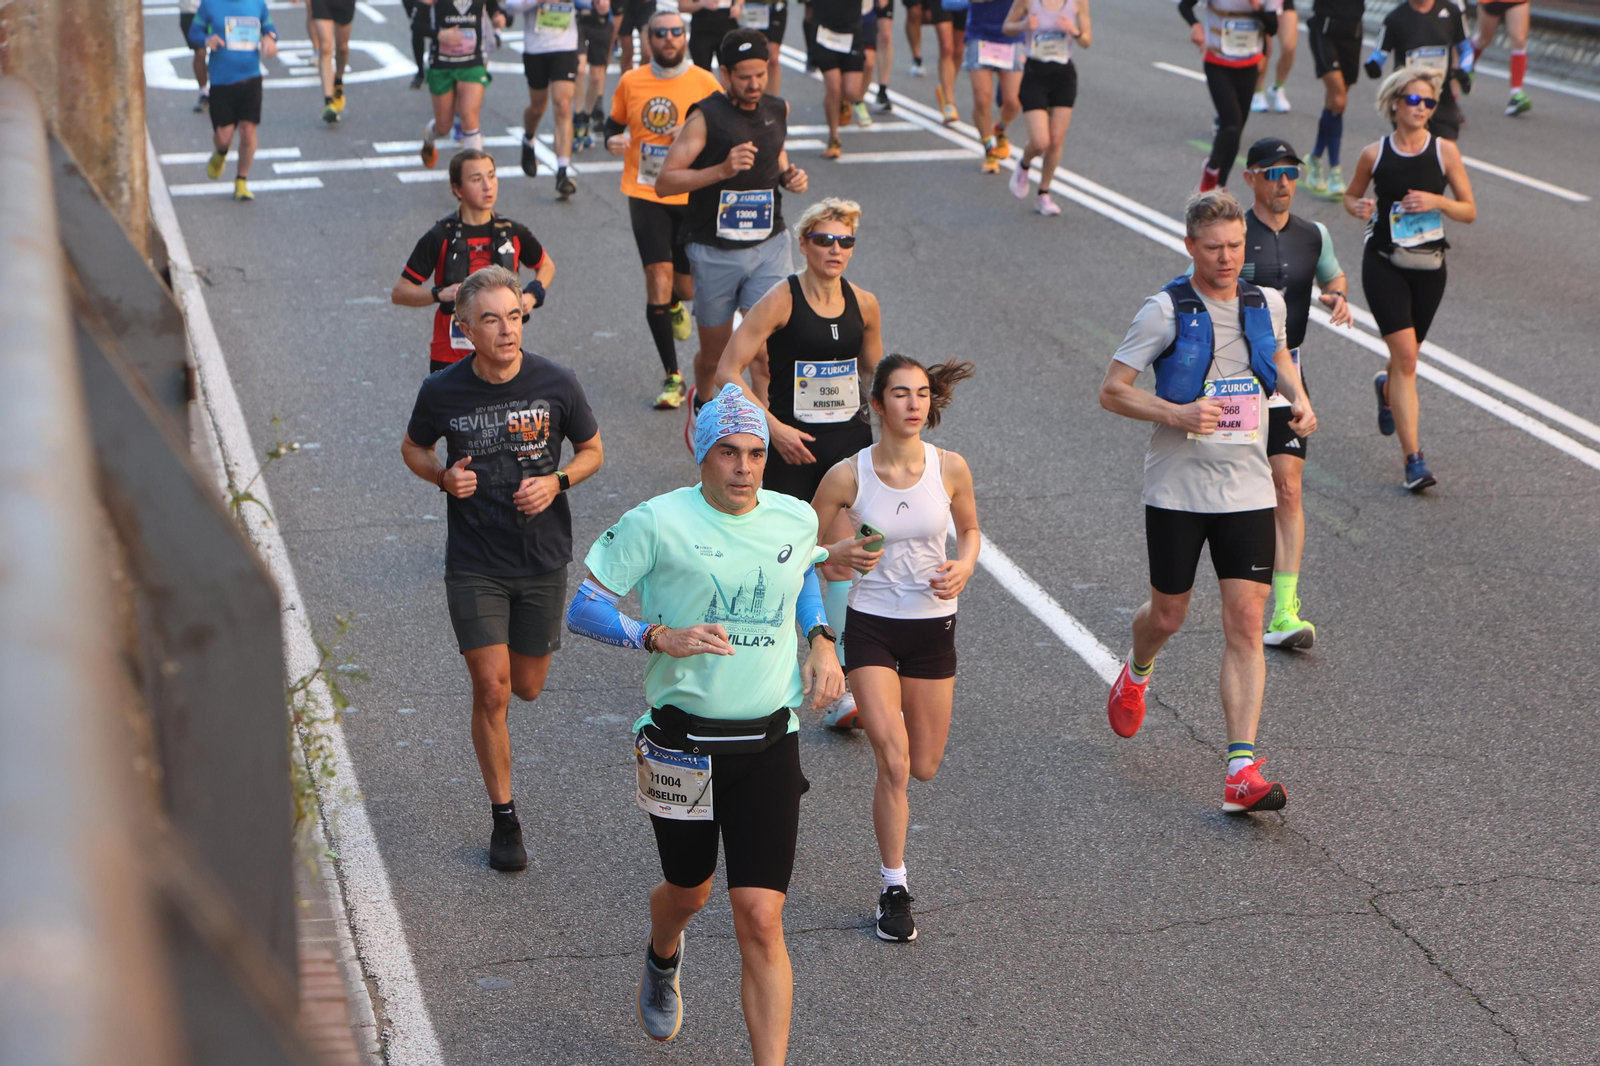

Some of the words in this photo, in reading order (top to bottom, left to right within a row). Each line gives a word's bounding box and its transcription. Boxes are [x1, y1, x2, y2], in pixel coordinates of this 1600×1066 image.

[739, 193, 768, 202] ZURICH
[820, 364, 850, 376] ZURICH
[819, 386, 840, 396] 9360
[1220, 383, 1254, 393] ZURICH
[813, 399, 846, 408] KRISTINA
[508, 408, 544, 433] SEV
[481, 427, 499, 439] SEV
[646, 787, 688, 803] JOSELITO
